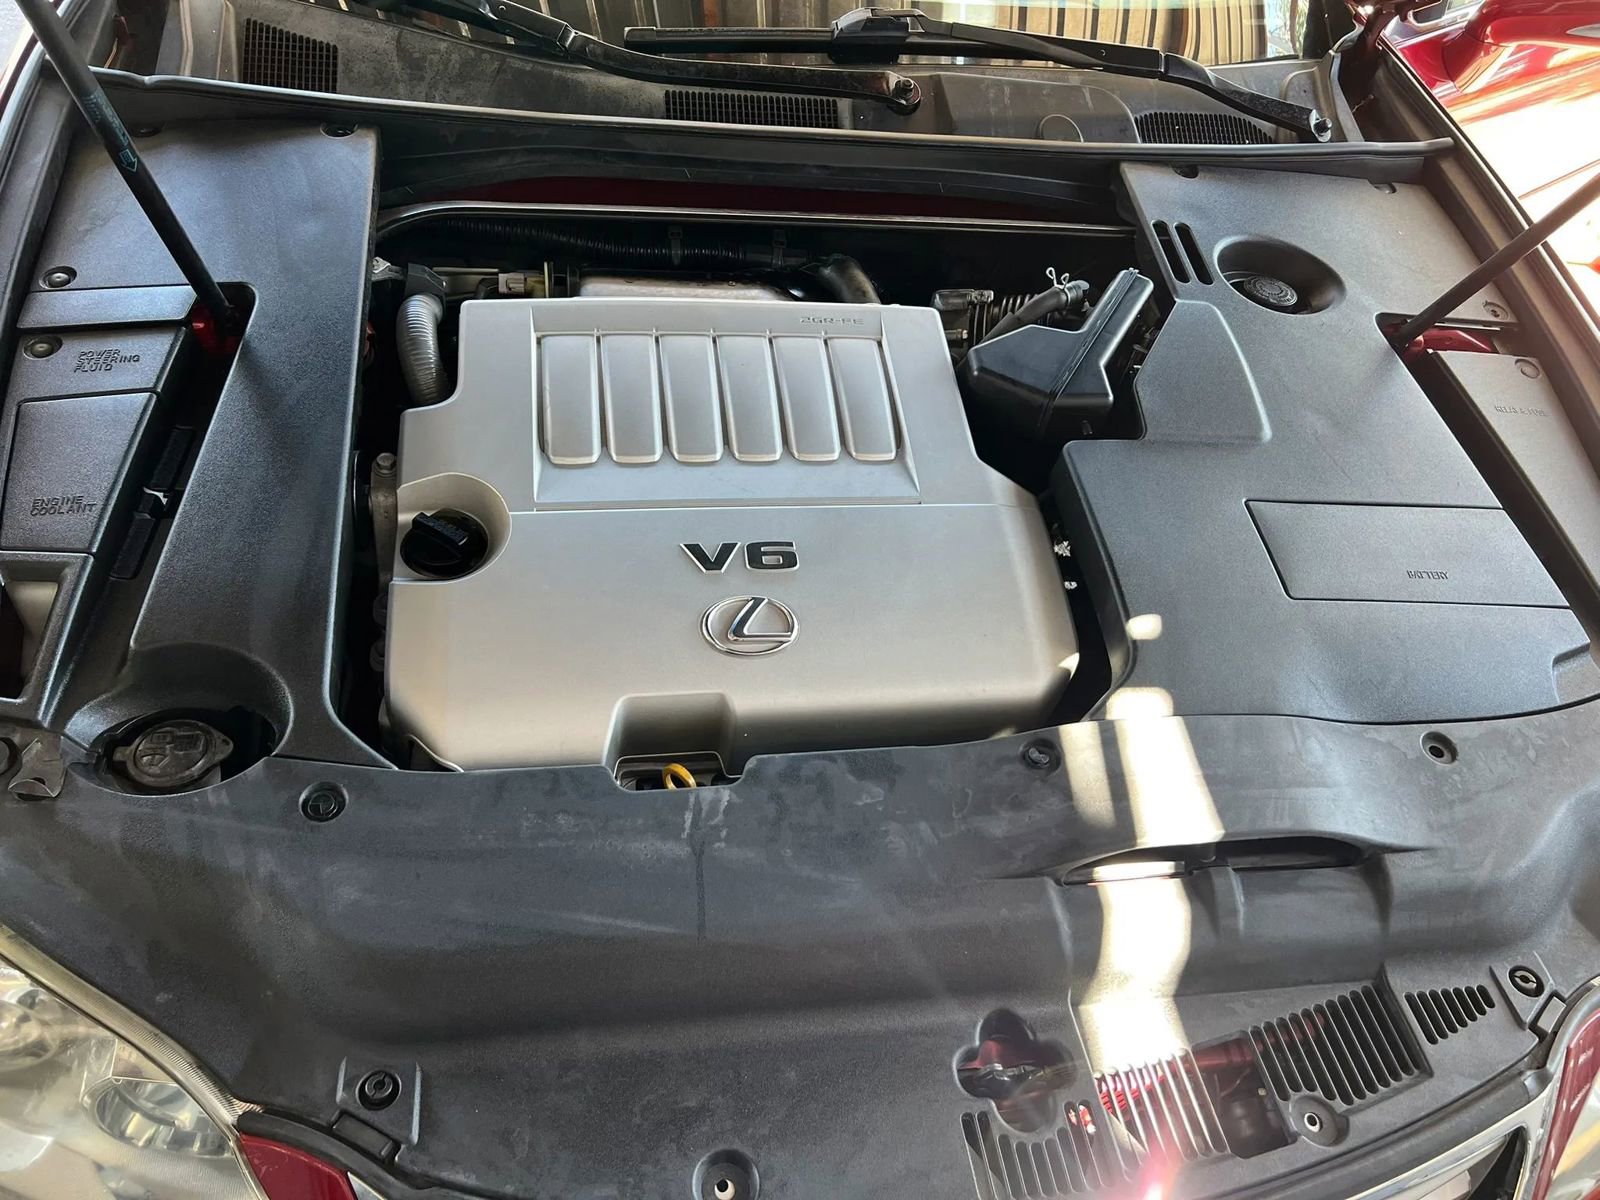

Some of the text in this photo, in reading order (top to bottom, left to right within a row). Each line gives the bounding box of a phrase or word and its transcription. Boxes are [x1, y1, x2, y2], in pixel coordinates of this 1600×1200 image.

[77, 354, 140, 364] STEERING
[79, 349, 120, 358] POWER
[74, 362, 113, 373] FLUID
[32, 495, 84, 508] ENGINE
[30, 503, 97, 516] COOLANT
[680, 541, 800, 574] V6
